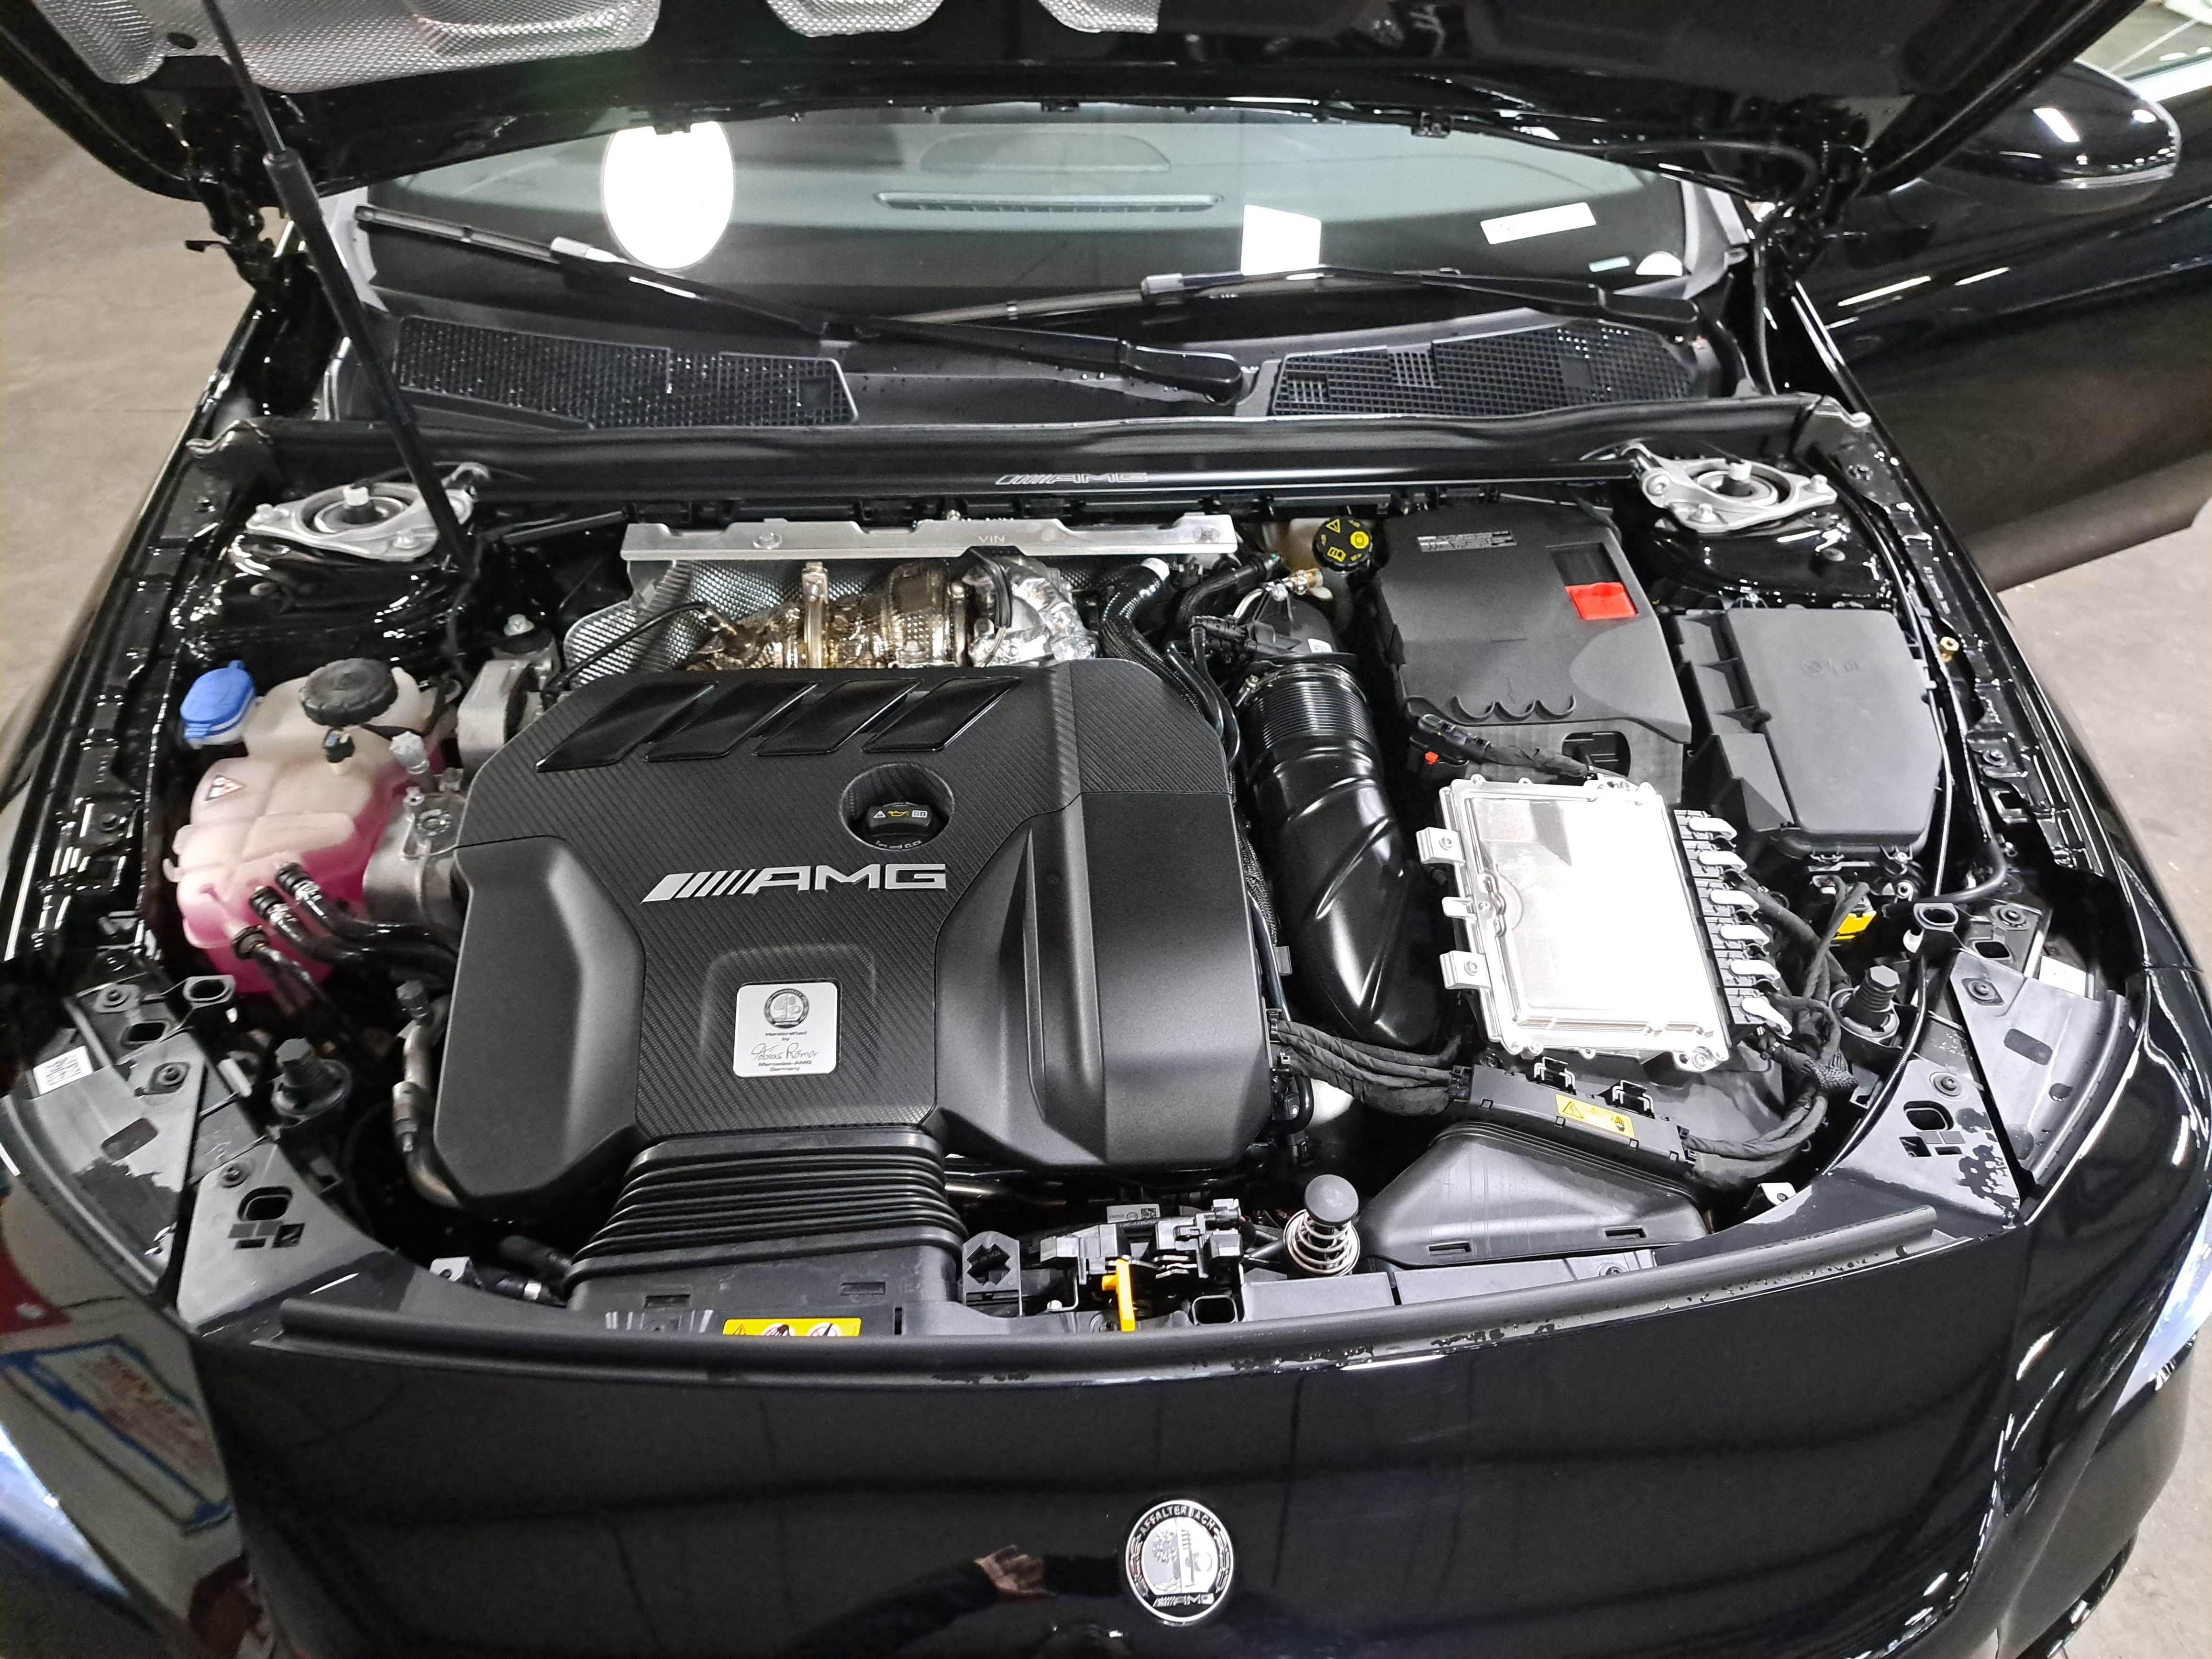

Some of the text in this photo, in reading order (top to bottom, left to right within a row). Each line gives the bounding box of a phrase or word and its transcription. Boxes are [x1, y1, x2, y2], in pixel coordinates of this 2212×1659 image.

[1046, 473, 1147, 484] AMG
[978, 535, 1005, 543] VIN
[742, 863, 946, 895] AMG
[1140, 1505, 1216, 1535] AFFALTERBACH
